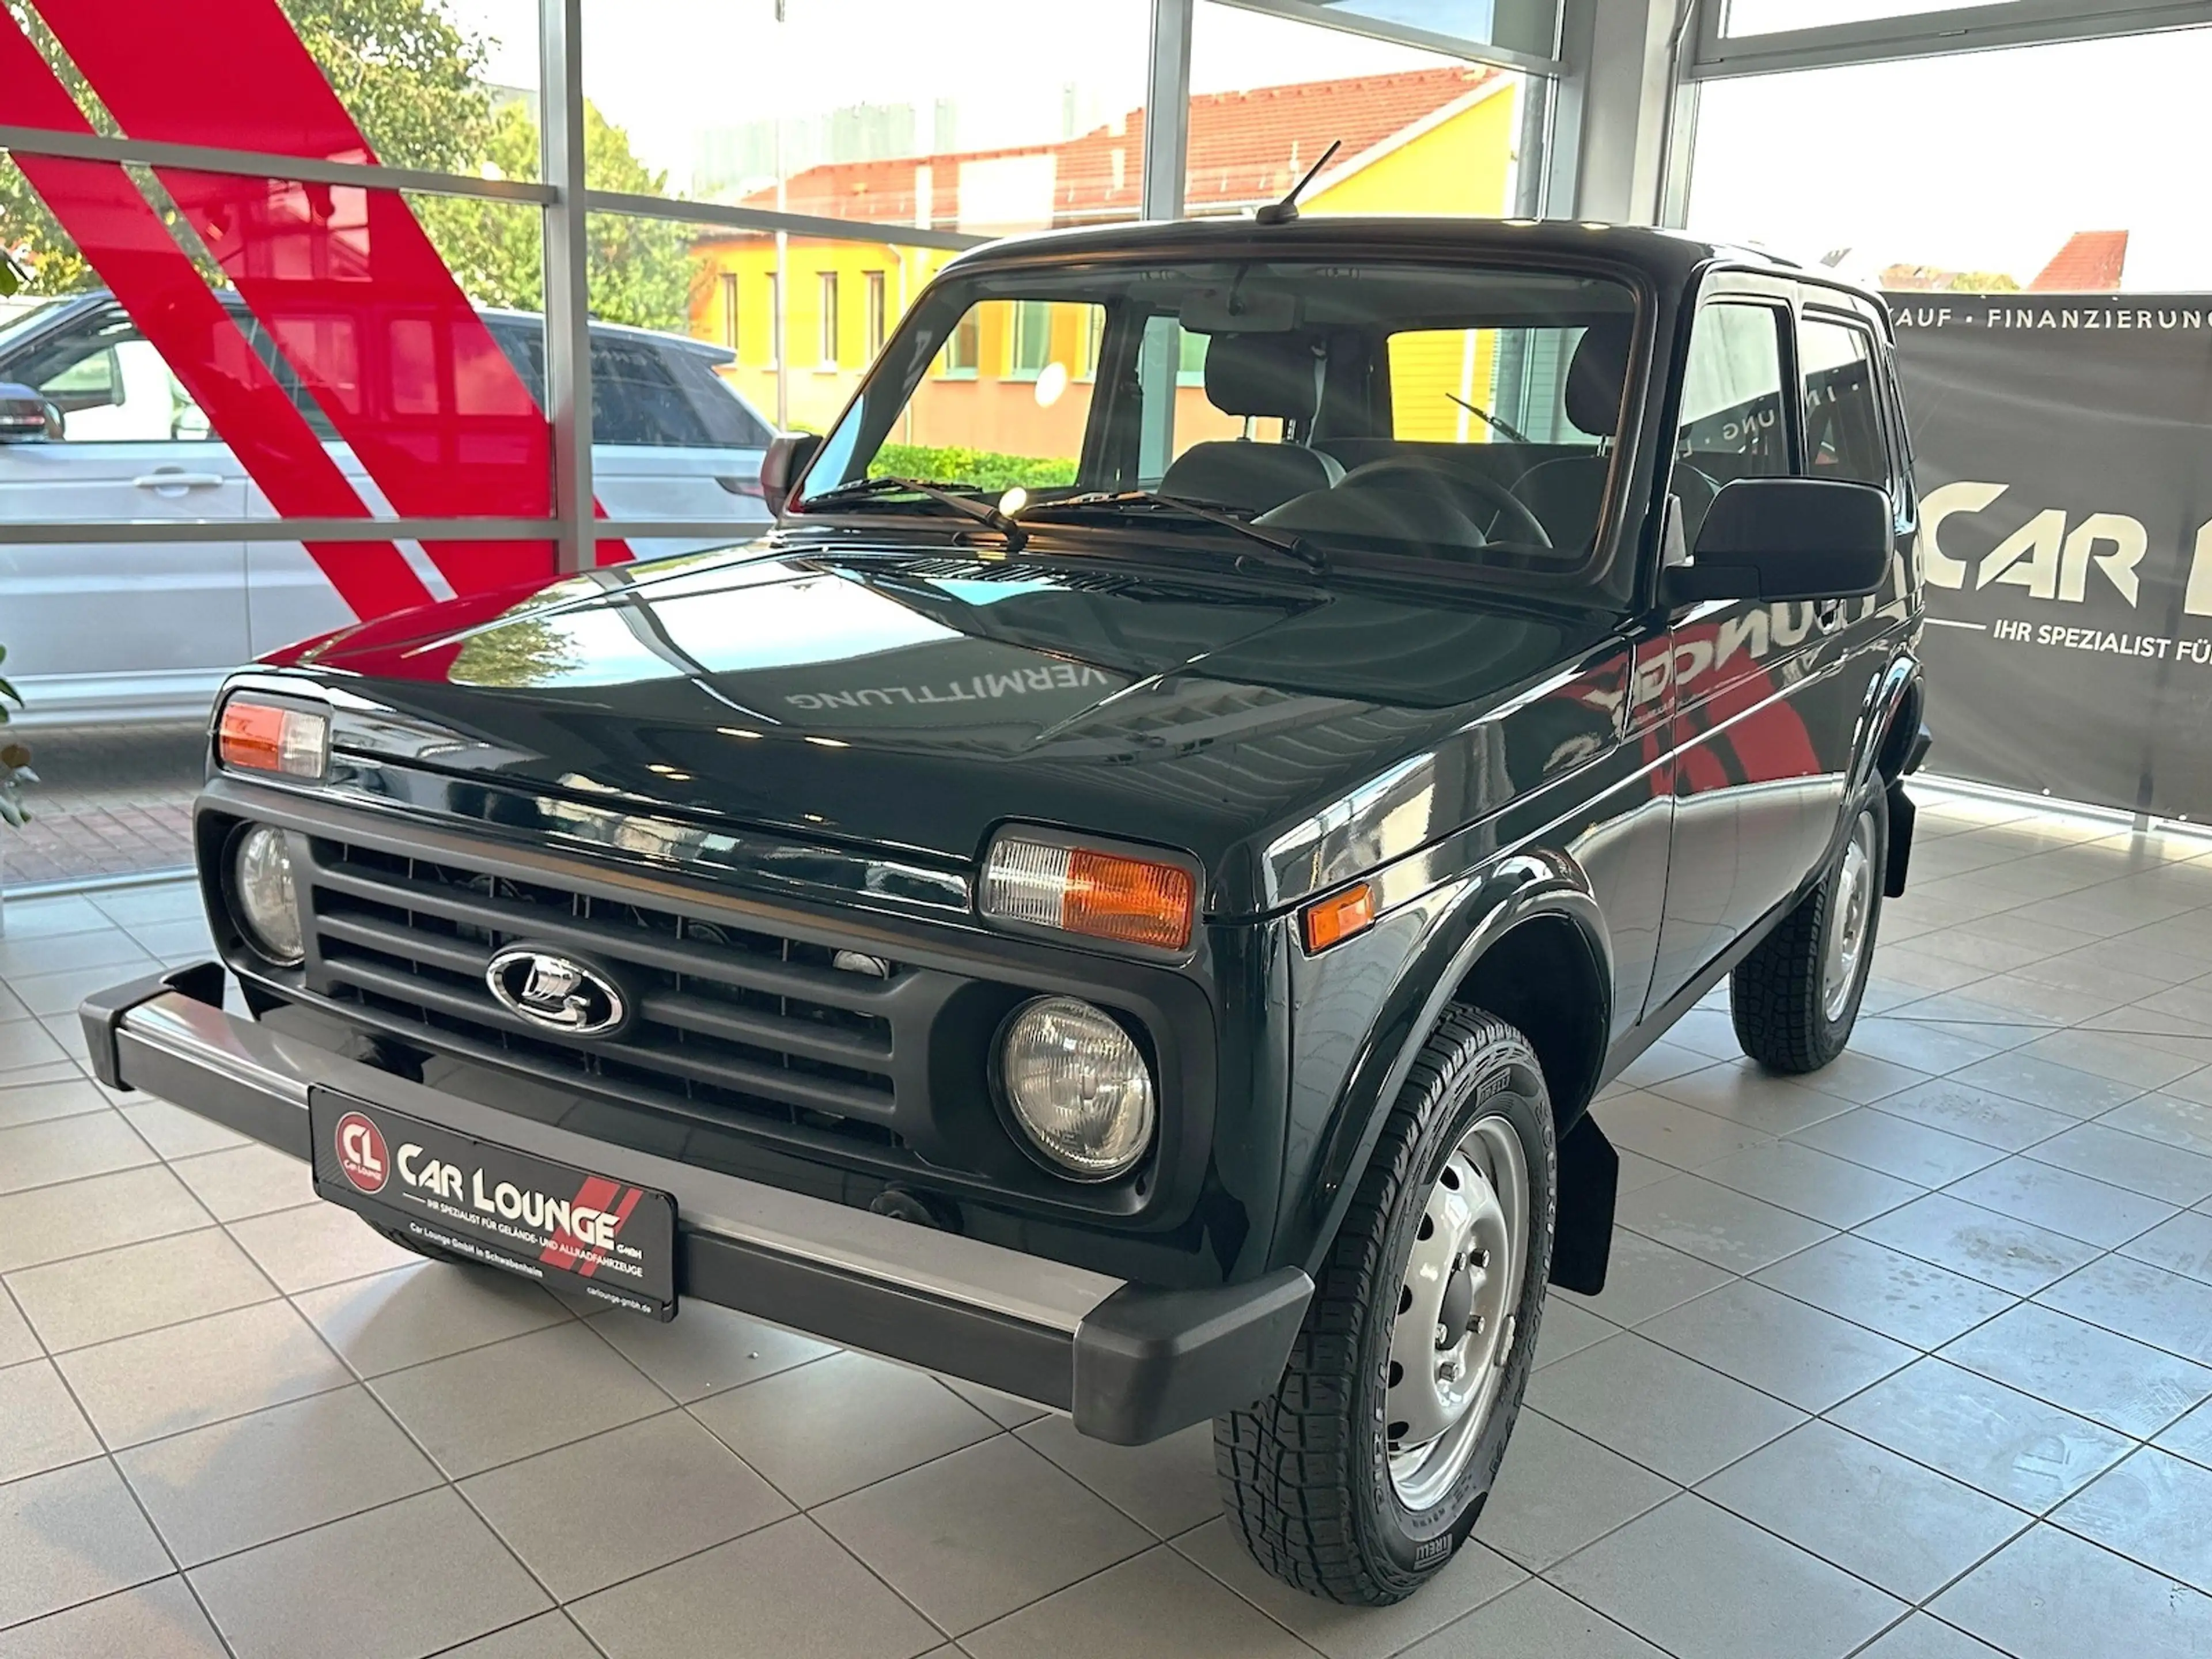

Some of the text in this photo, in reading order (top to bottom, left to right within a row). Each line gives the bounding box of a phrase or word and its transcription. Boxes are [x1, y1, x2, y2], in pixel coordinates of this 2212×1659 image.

[1889, 308, 2212, 329] AUF FINANZIERUN
[1919, 481, 2148, 609] CAR
[1993, 619, 2212, 665] IHR SPEZIALIST FÜ
[786, 664, 1108, 710] VERMITTLUNG
[343, 1123, 381, 1171] CL
[397, 1143, 464, 1202] CAR
[472, 1168, 620, 1251] LOUNGE
[410, 1222, 423, 1234] Car
[424, 1228, 450, 1245] Lounge
[475, 1246, 484, 1257] in
[484, 1249, 543, 1278] Schwabenheim
[427, 1198, 643, 1277] IHR SPEZIALIST FÜR GELÄNDE- UND ALLRADFAHRZEUGE
